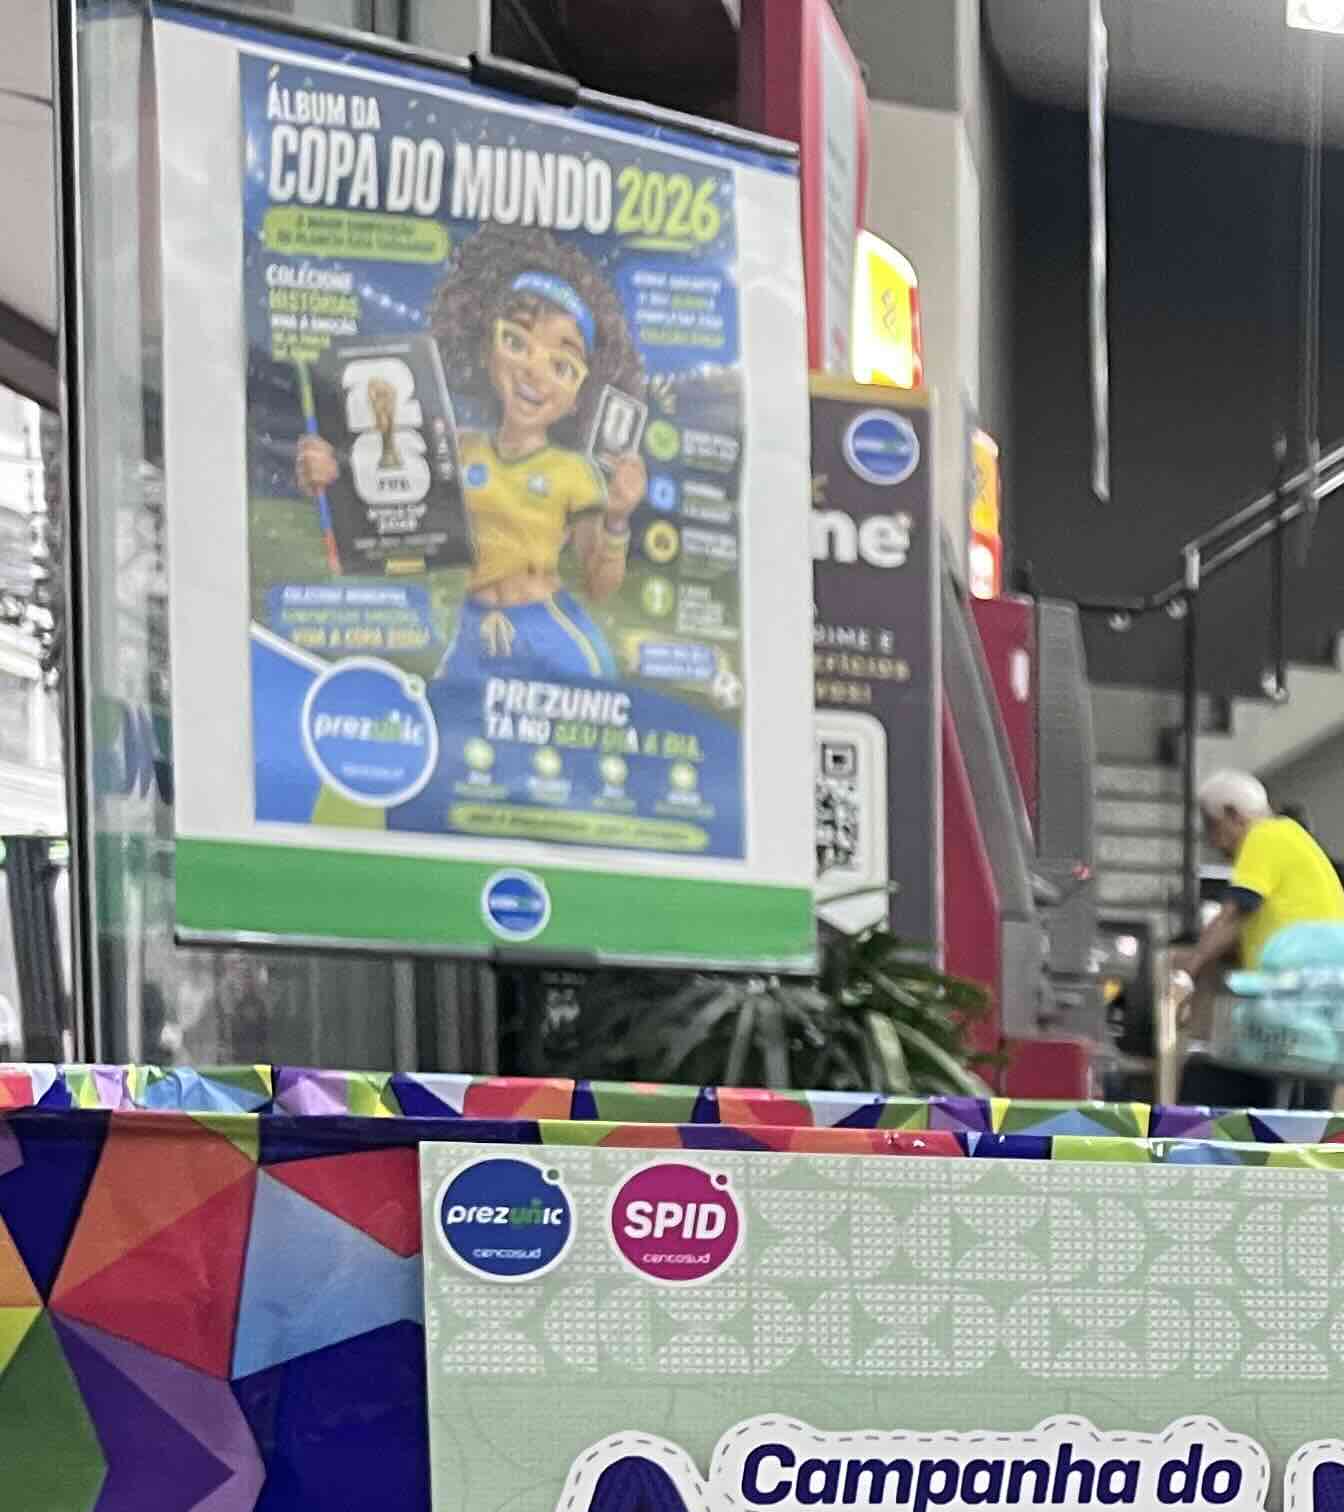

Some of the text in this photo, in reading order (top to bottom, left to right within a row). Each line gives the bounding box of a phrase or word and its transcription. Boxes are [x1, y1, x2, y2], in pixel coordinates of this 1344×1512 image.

[267, 64, 381, 129] ÁLBUM DA
[268, 124, 379, 210] COPA
[385, 135, 445, 217] DO
[451, 140, 612, 235] MUNDO
[614, 165, 720, 242] 2026
[486, 677, 632, 727] PREZUNIC
[447, 1198, 563, 1226] prezunic
[624, 1200, 727, 1240] SPID
[472, 1248, 542, 1259] cencosud
[643, 1253, 711, 1264] cencosud
[1154, 1444, 1243, 1505] do
